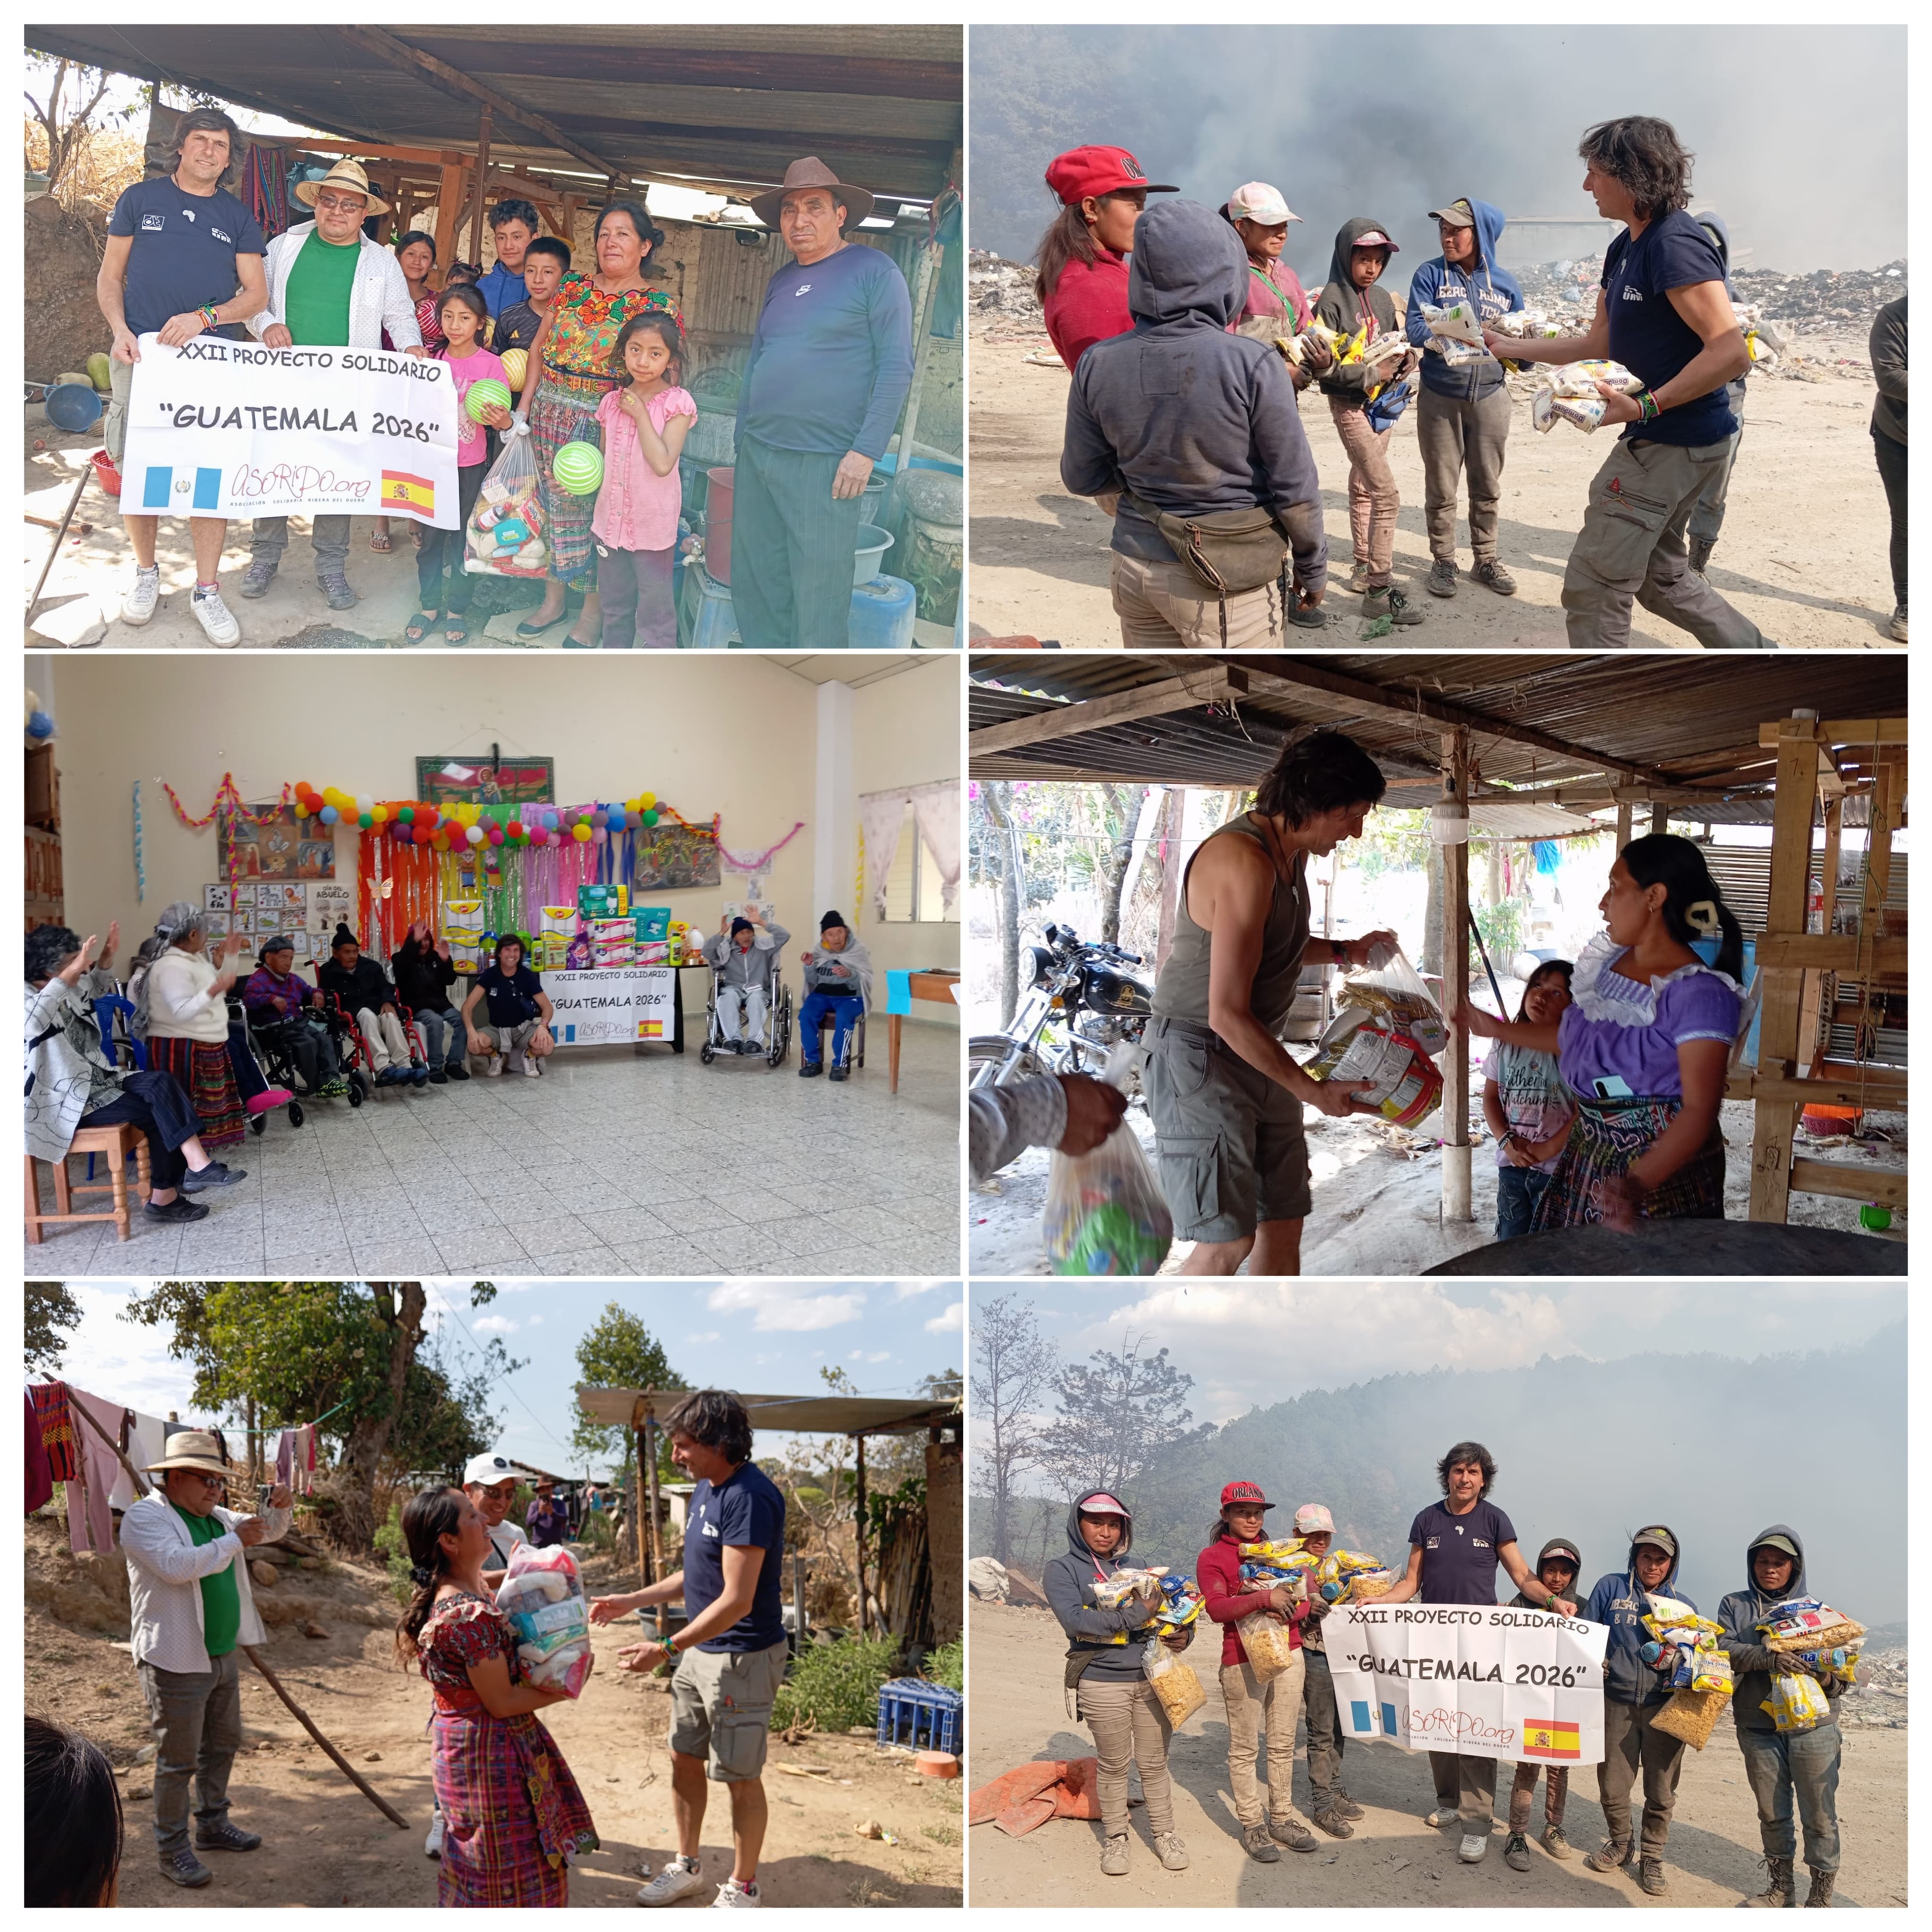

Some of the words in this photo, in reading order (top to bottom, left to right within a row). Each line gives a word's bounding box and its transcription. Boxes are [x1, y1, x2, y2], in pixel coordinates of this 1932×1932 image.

[176, 342, 227, 361] XXII
[233, 348, 333, 368] PROYECTO
[341, 354, 441, 382] SOLIDARIO
[159, 403, 358, 432] "GUATEMALA
[372, 412, 440, 443] 2026"
[579, 972, 620, 980] PROYECTO
[624, 971, 667, 979] SOLIDARIO
[550, 996, 631, 1009] "GUATEMALA
[635, 994, 666, 1005] 2026"
[1349, 1610, 1388, 1624] XXII
[1395, 1610, 1482, 1625] PROYECTO
[1489, 1613, 1589, 1634] SOLIDARIO
[1614, 1613, 1621, 1624] &
[1626, 1614, 1637, 1625] FI
[1347, 1654, 1503, 1682] "GUATEMALA
[1516, 1664, 1587, 1688] 2026"
